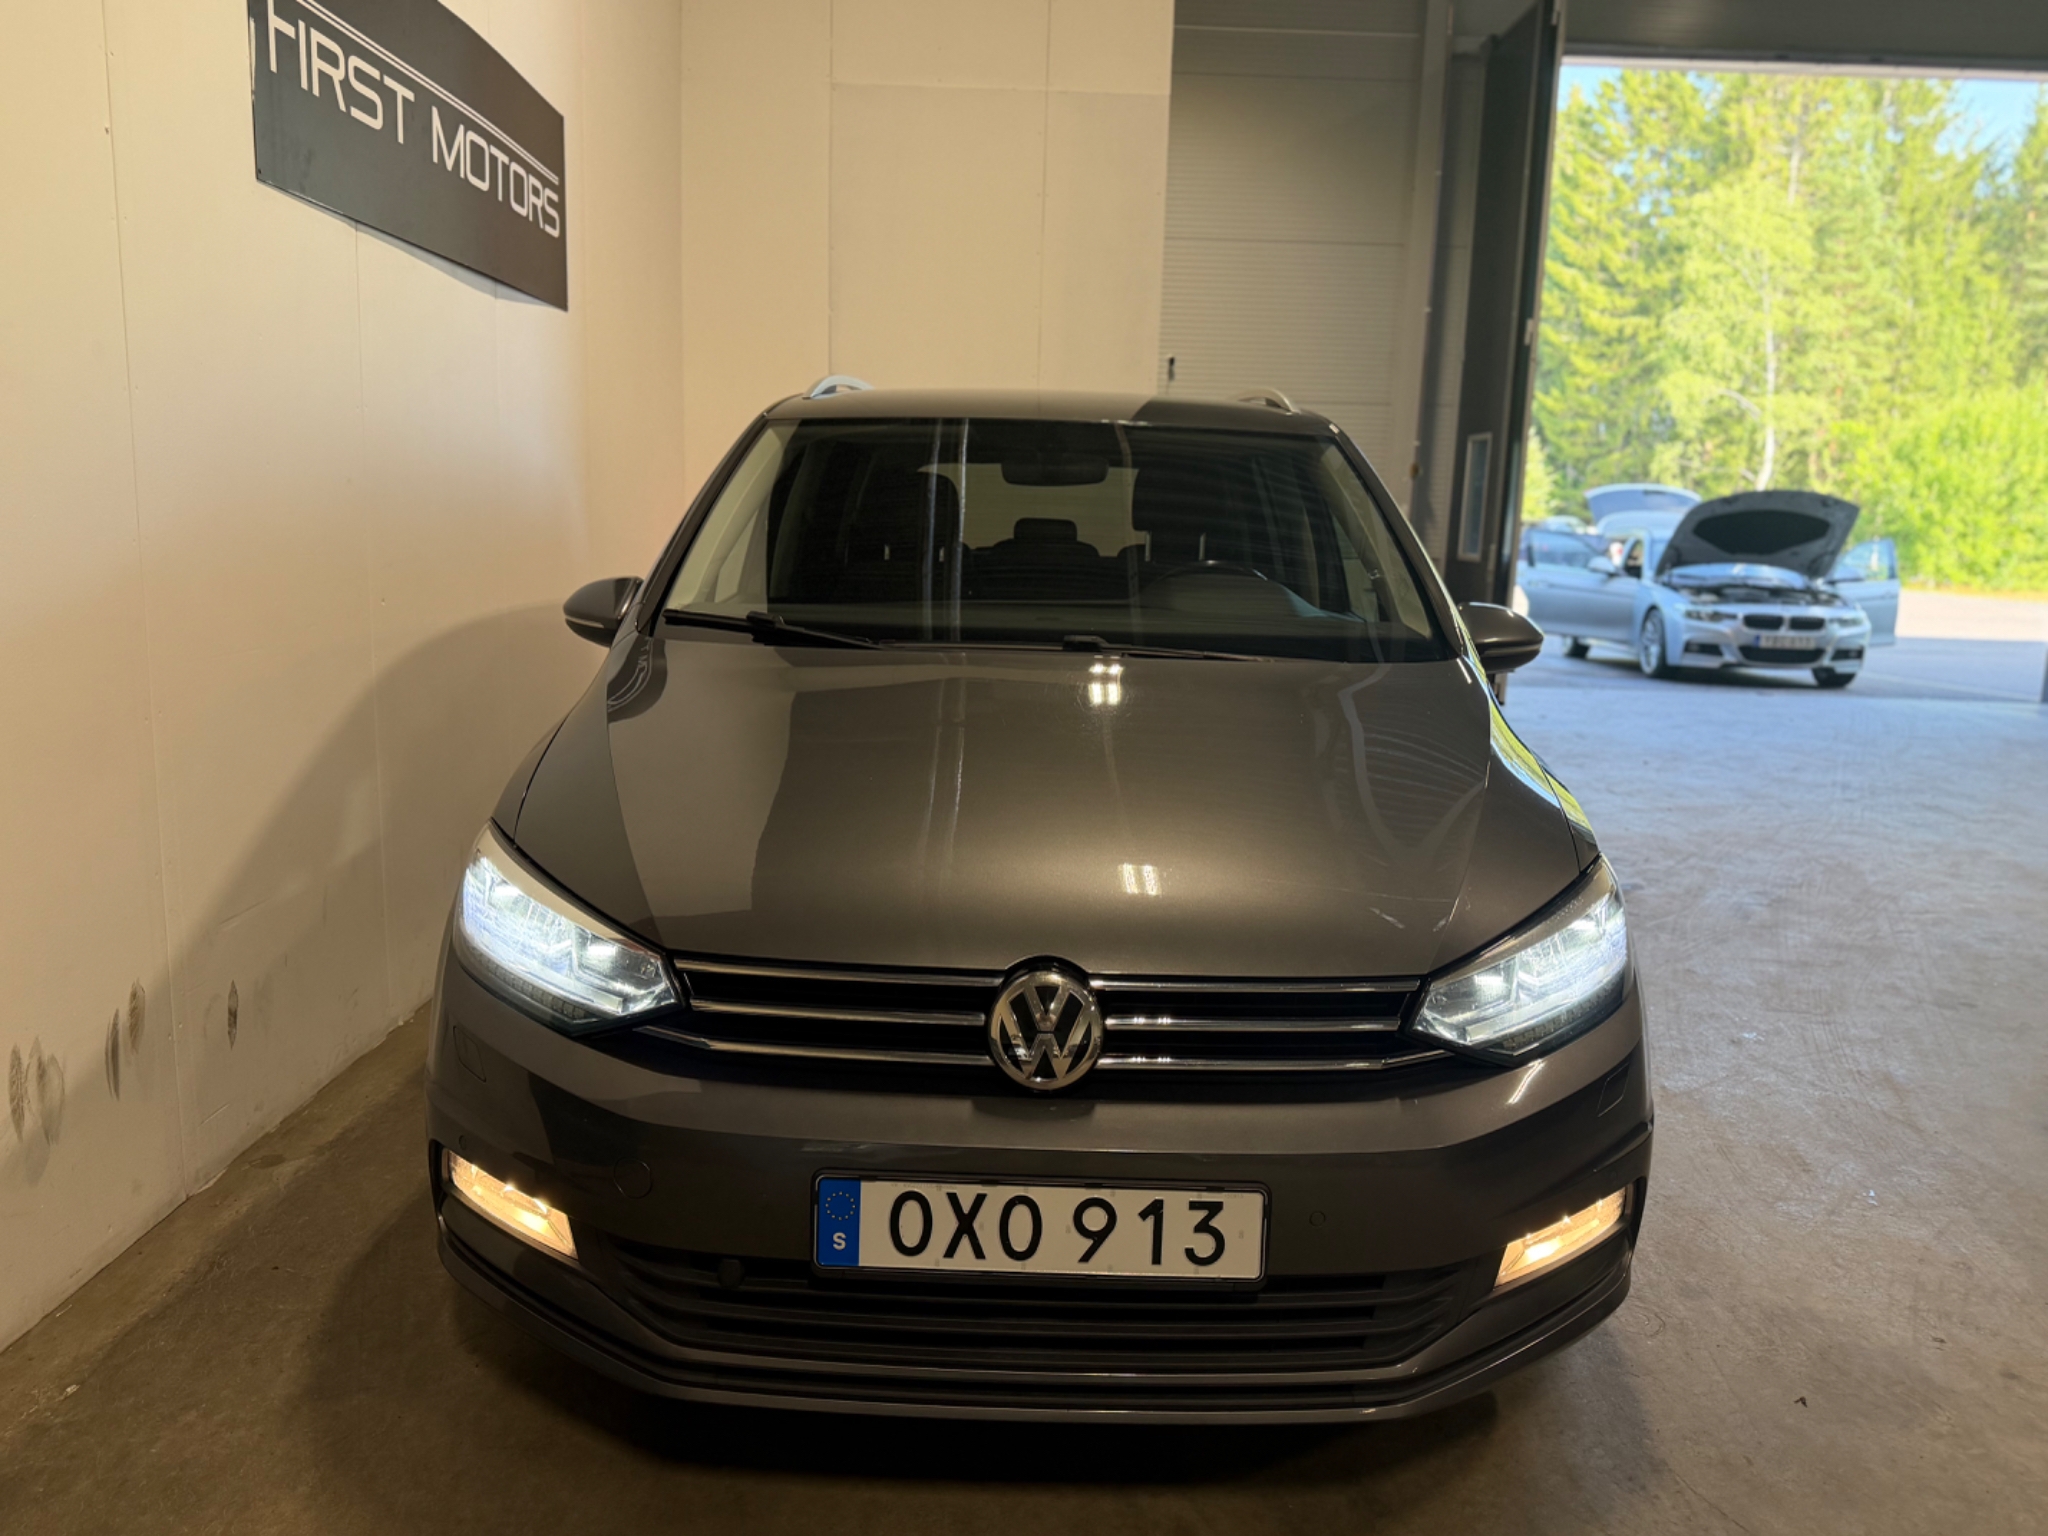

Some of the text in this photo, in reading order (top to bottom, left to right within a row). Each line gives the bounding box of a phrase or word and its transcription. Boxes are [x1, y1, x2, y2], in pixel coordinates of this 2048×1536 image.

[267, 0, 560, 238] FIRST MOTORS
[832, 1232, 847, 1251] S
[888, 1190, 1226, 1267] OXO 913
